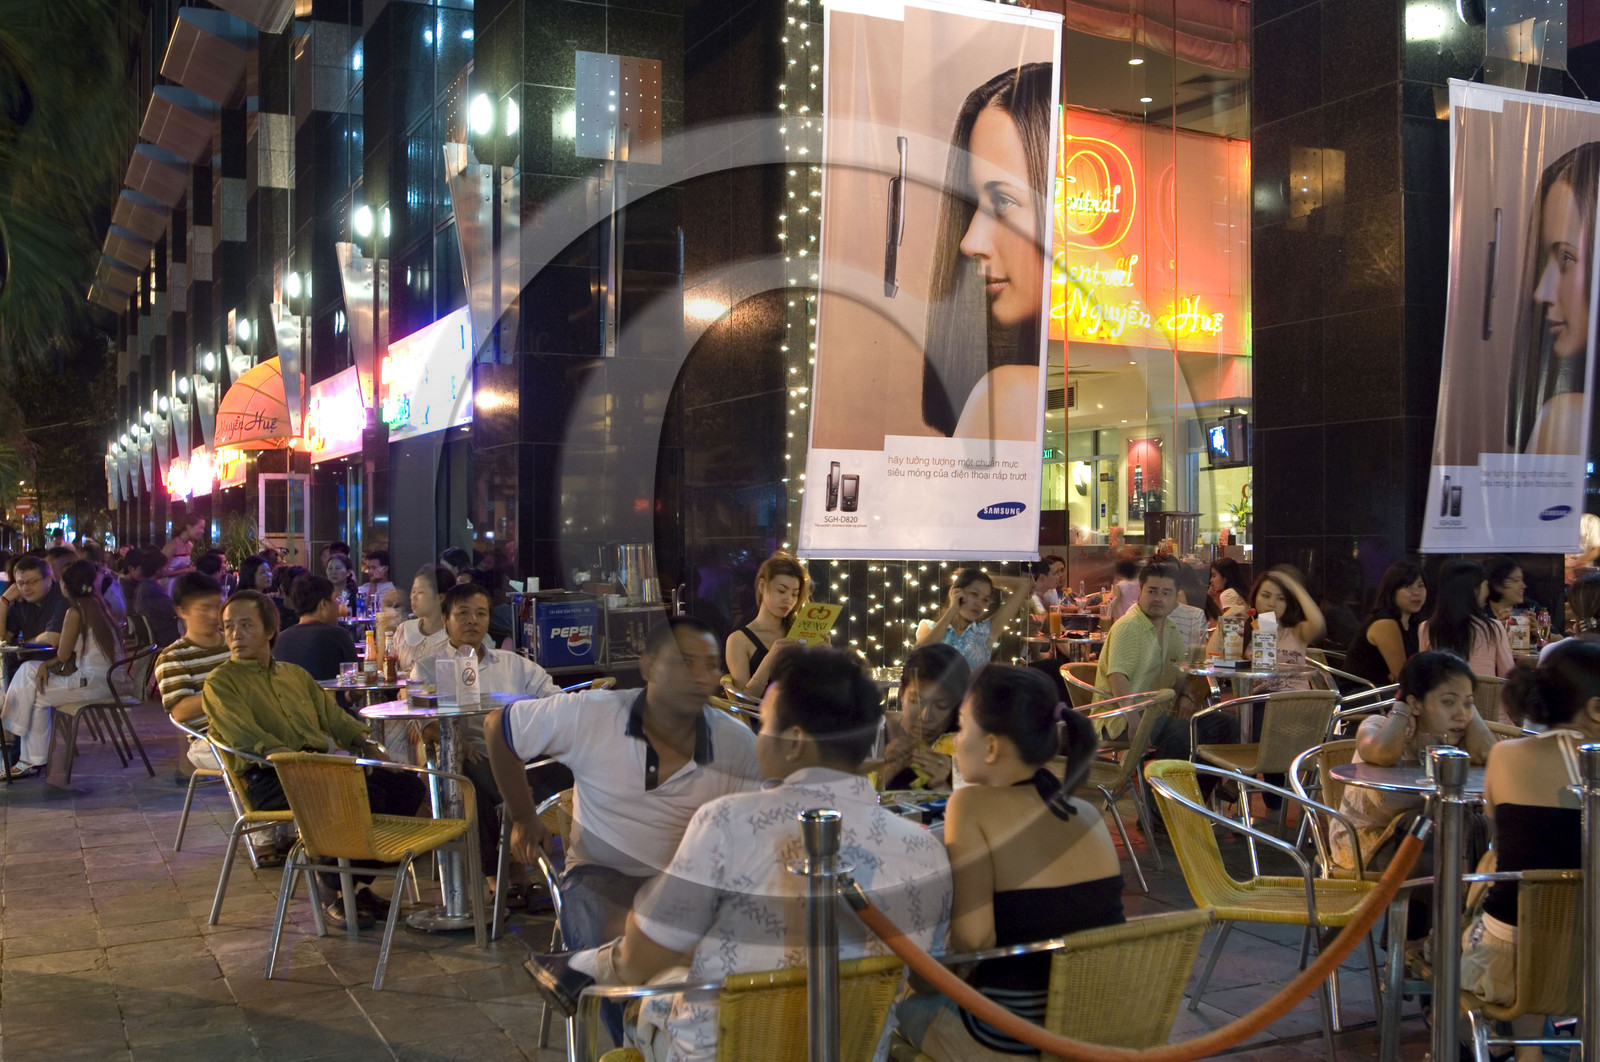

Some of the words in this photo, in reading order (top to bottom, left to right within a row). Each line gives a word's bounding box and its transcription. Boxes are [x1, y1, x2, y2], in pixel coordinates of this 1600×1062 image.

[1051, 251, 1138, 287] Central
[1050, 287, 1152, 338] Nguyễn
[1166, 294, 1224, 336] Huệ
[244, 408, 280, 433] Huệ
[1043, 449, 1053, 459] XIT
[887, 455, 905, 466] hãy
[906, 456, 930, 467] tưởng
[932, 457, 956, 468] tượng
[957, 458, 974, 468] một
[975, 456, 1000, 468] chuẩn
[1001, 459, 1019, 469] mực
[887, 467, 905, 477] siêu
[933, 469, 949, 478] của
[951, 469, 969, 479] điện
[971, 470, 991, 480] thoại
[1009, 471, 1027, 481] trượt
[983, 507, 1021, 515] SAMSUNG
[824, 515, 858, 523] SGH-D820
[550, 625, 593, 638] PEPSI
